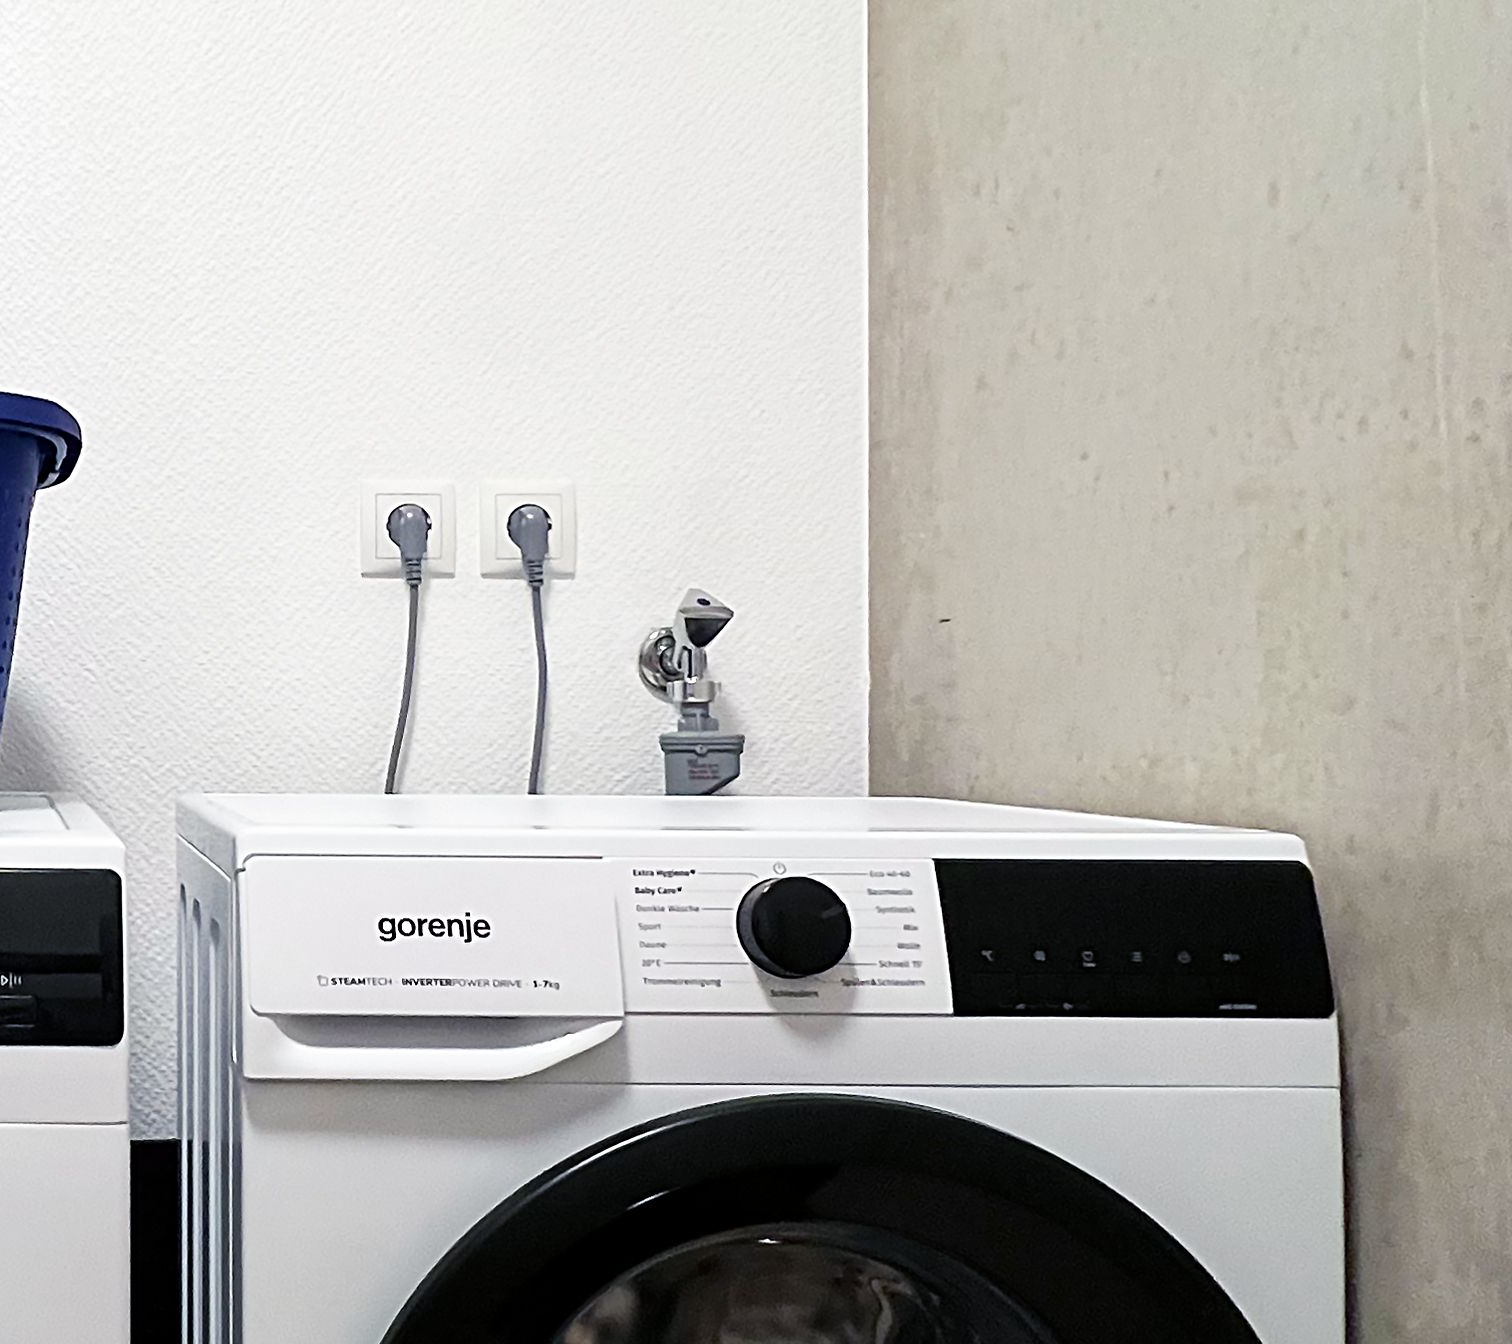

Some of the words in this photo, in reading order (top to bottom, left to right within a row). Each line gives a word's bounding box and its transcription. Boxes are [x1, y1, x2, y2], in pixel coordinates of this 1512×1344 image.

[635, 887, 655, 895] Baby
[378, 912, 491, 943] gorenje
[331, 977, 392, 986] STEAMTECH
